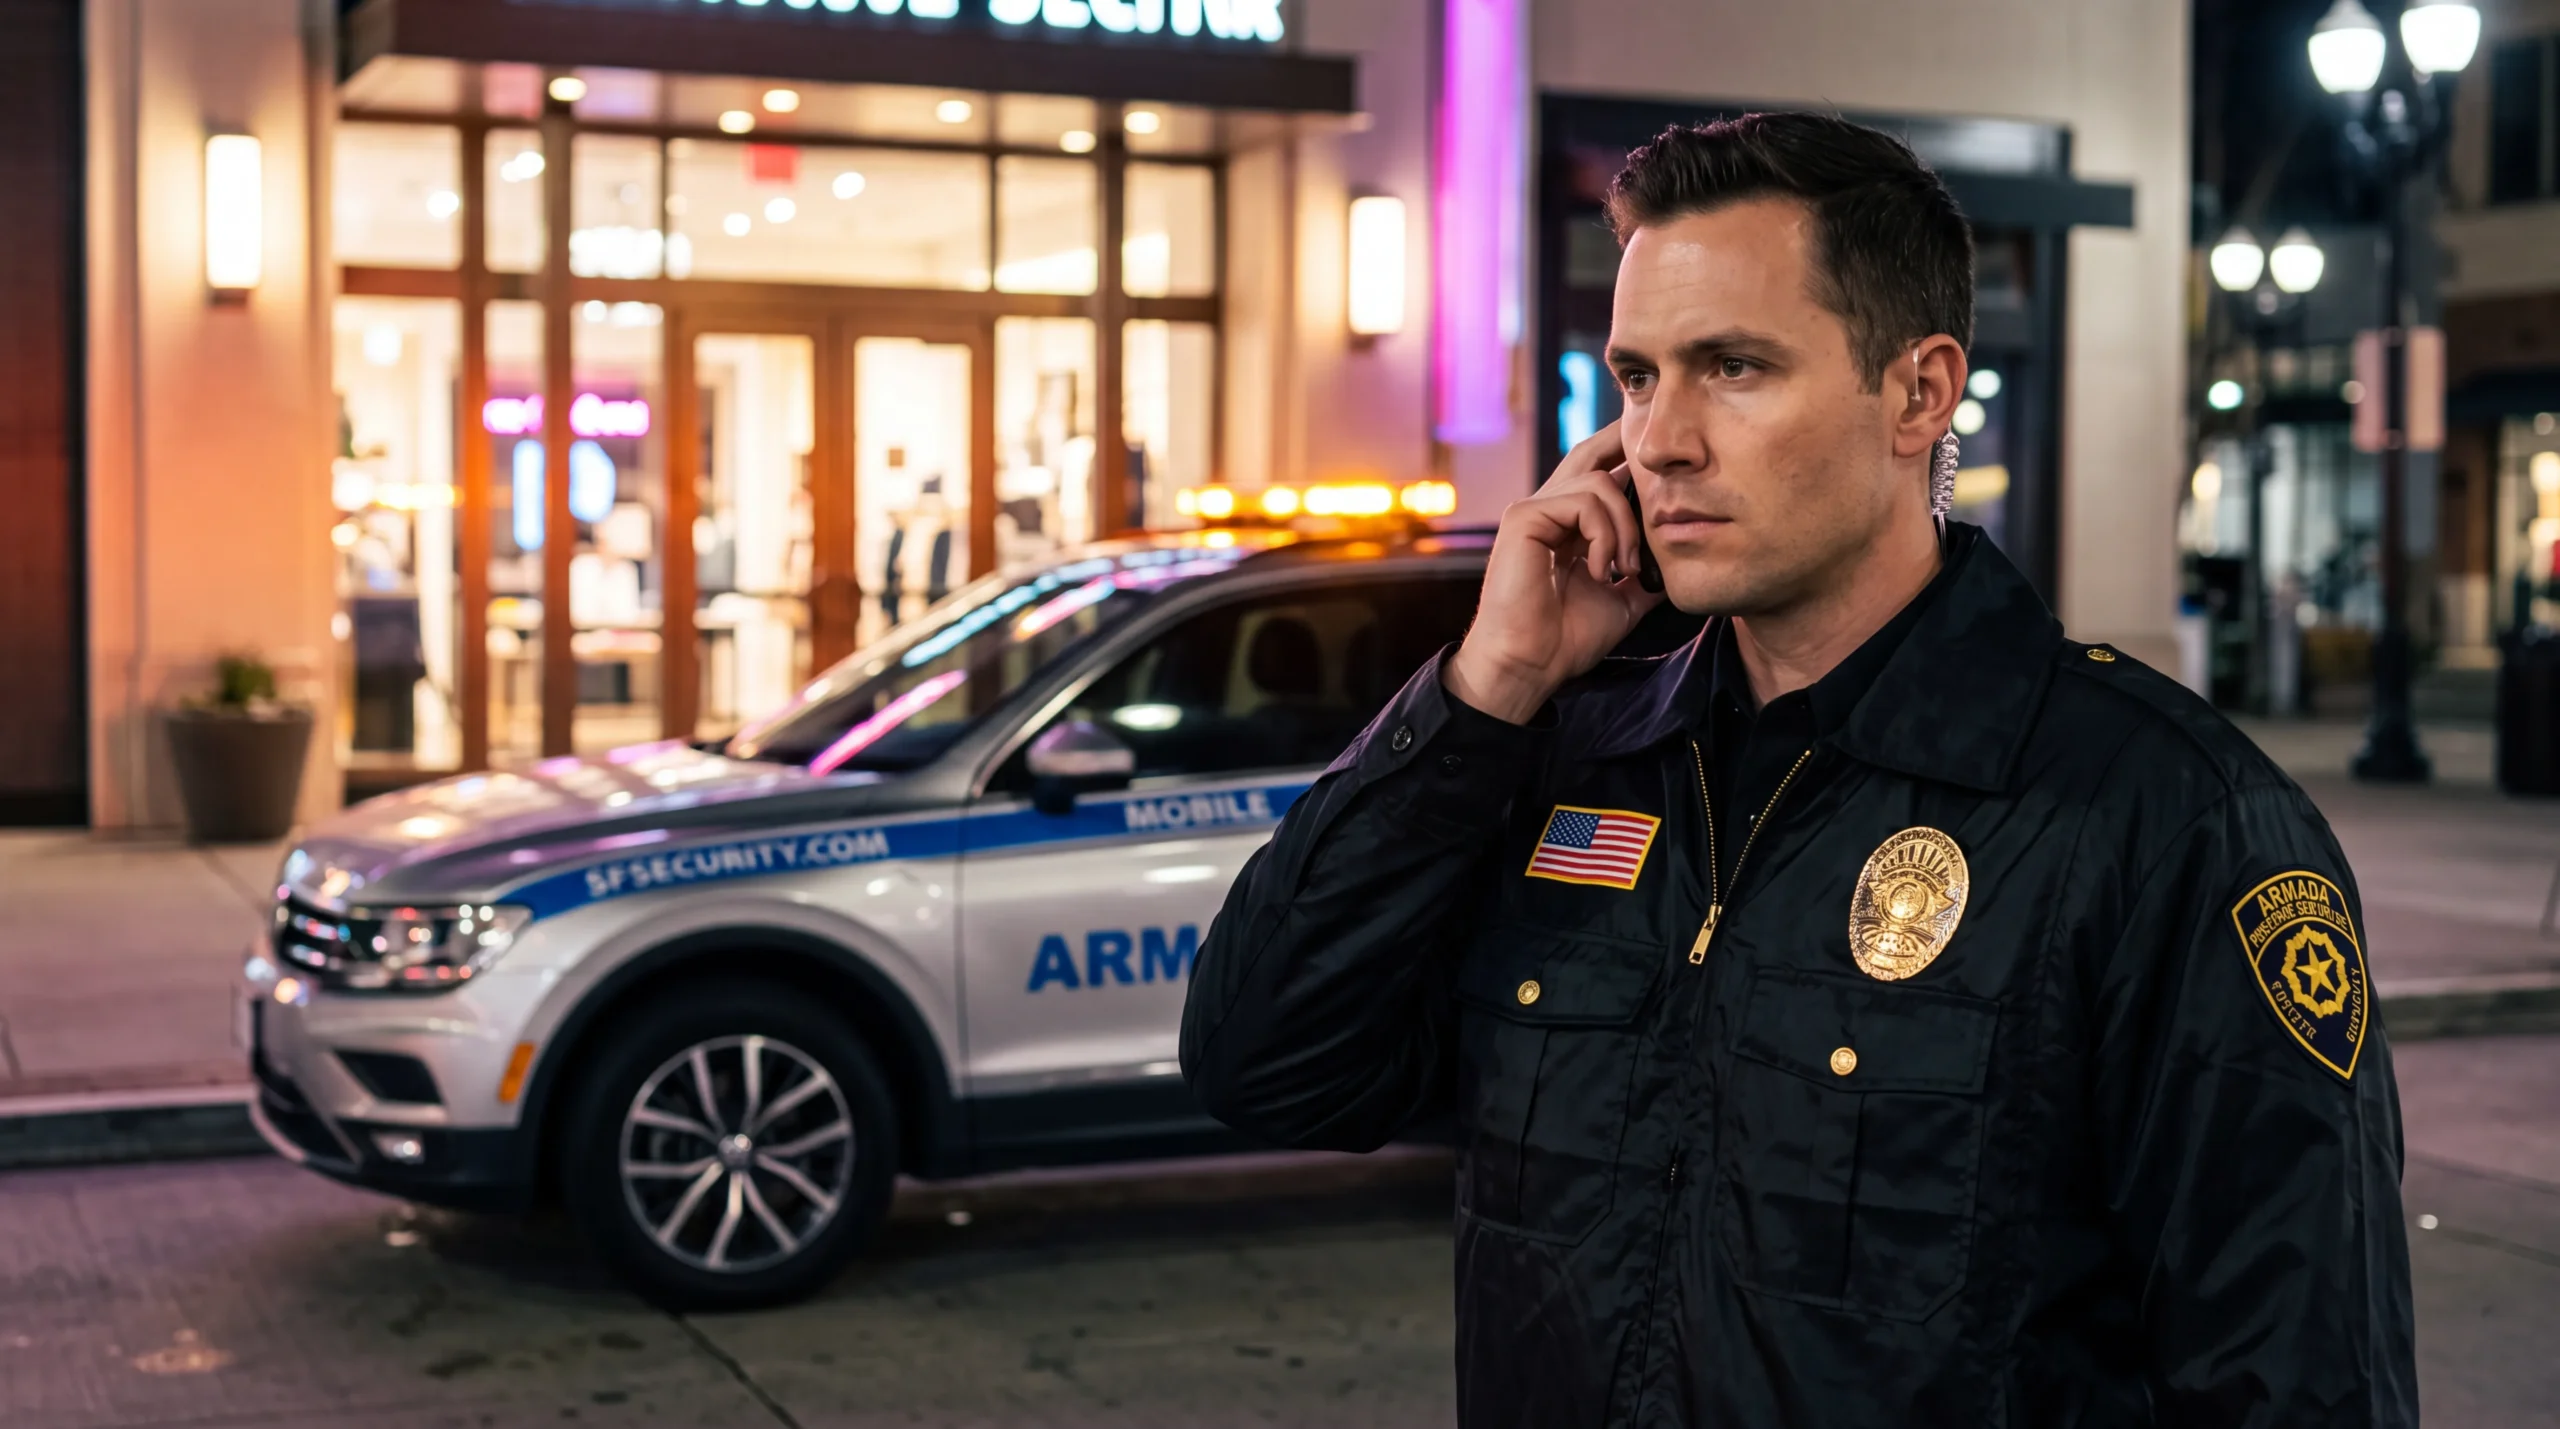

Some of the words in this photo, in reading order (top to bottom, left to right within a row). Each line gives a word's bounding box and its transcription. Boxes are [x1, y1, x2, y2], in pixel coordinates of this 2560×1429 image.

[1125, 790, 1272, 829] MOBILE
[585, 829, 890, 897] SFSECURITY.COM
[2257, 879, 2331, 917] ARMADA
